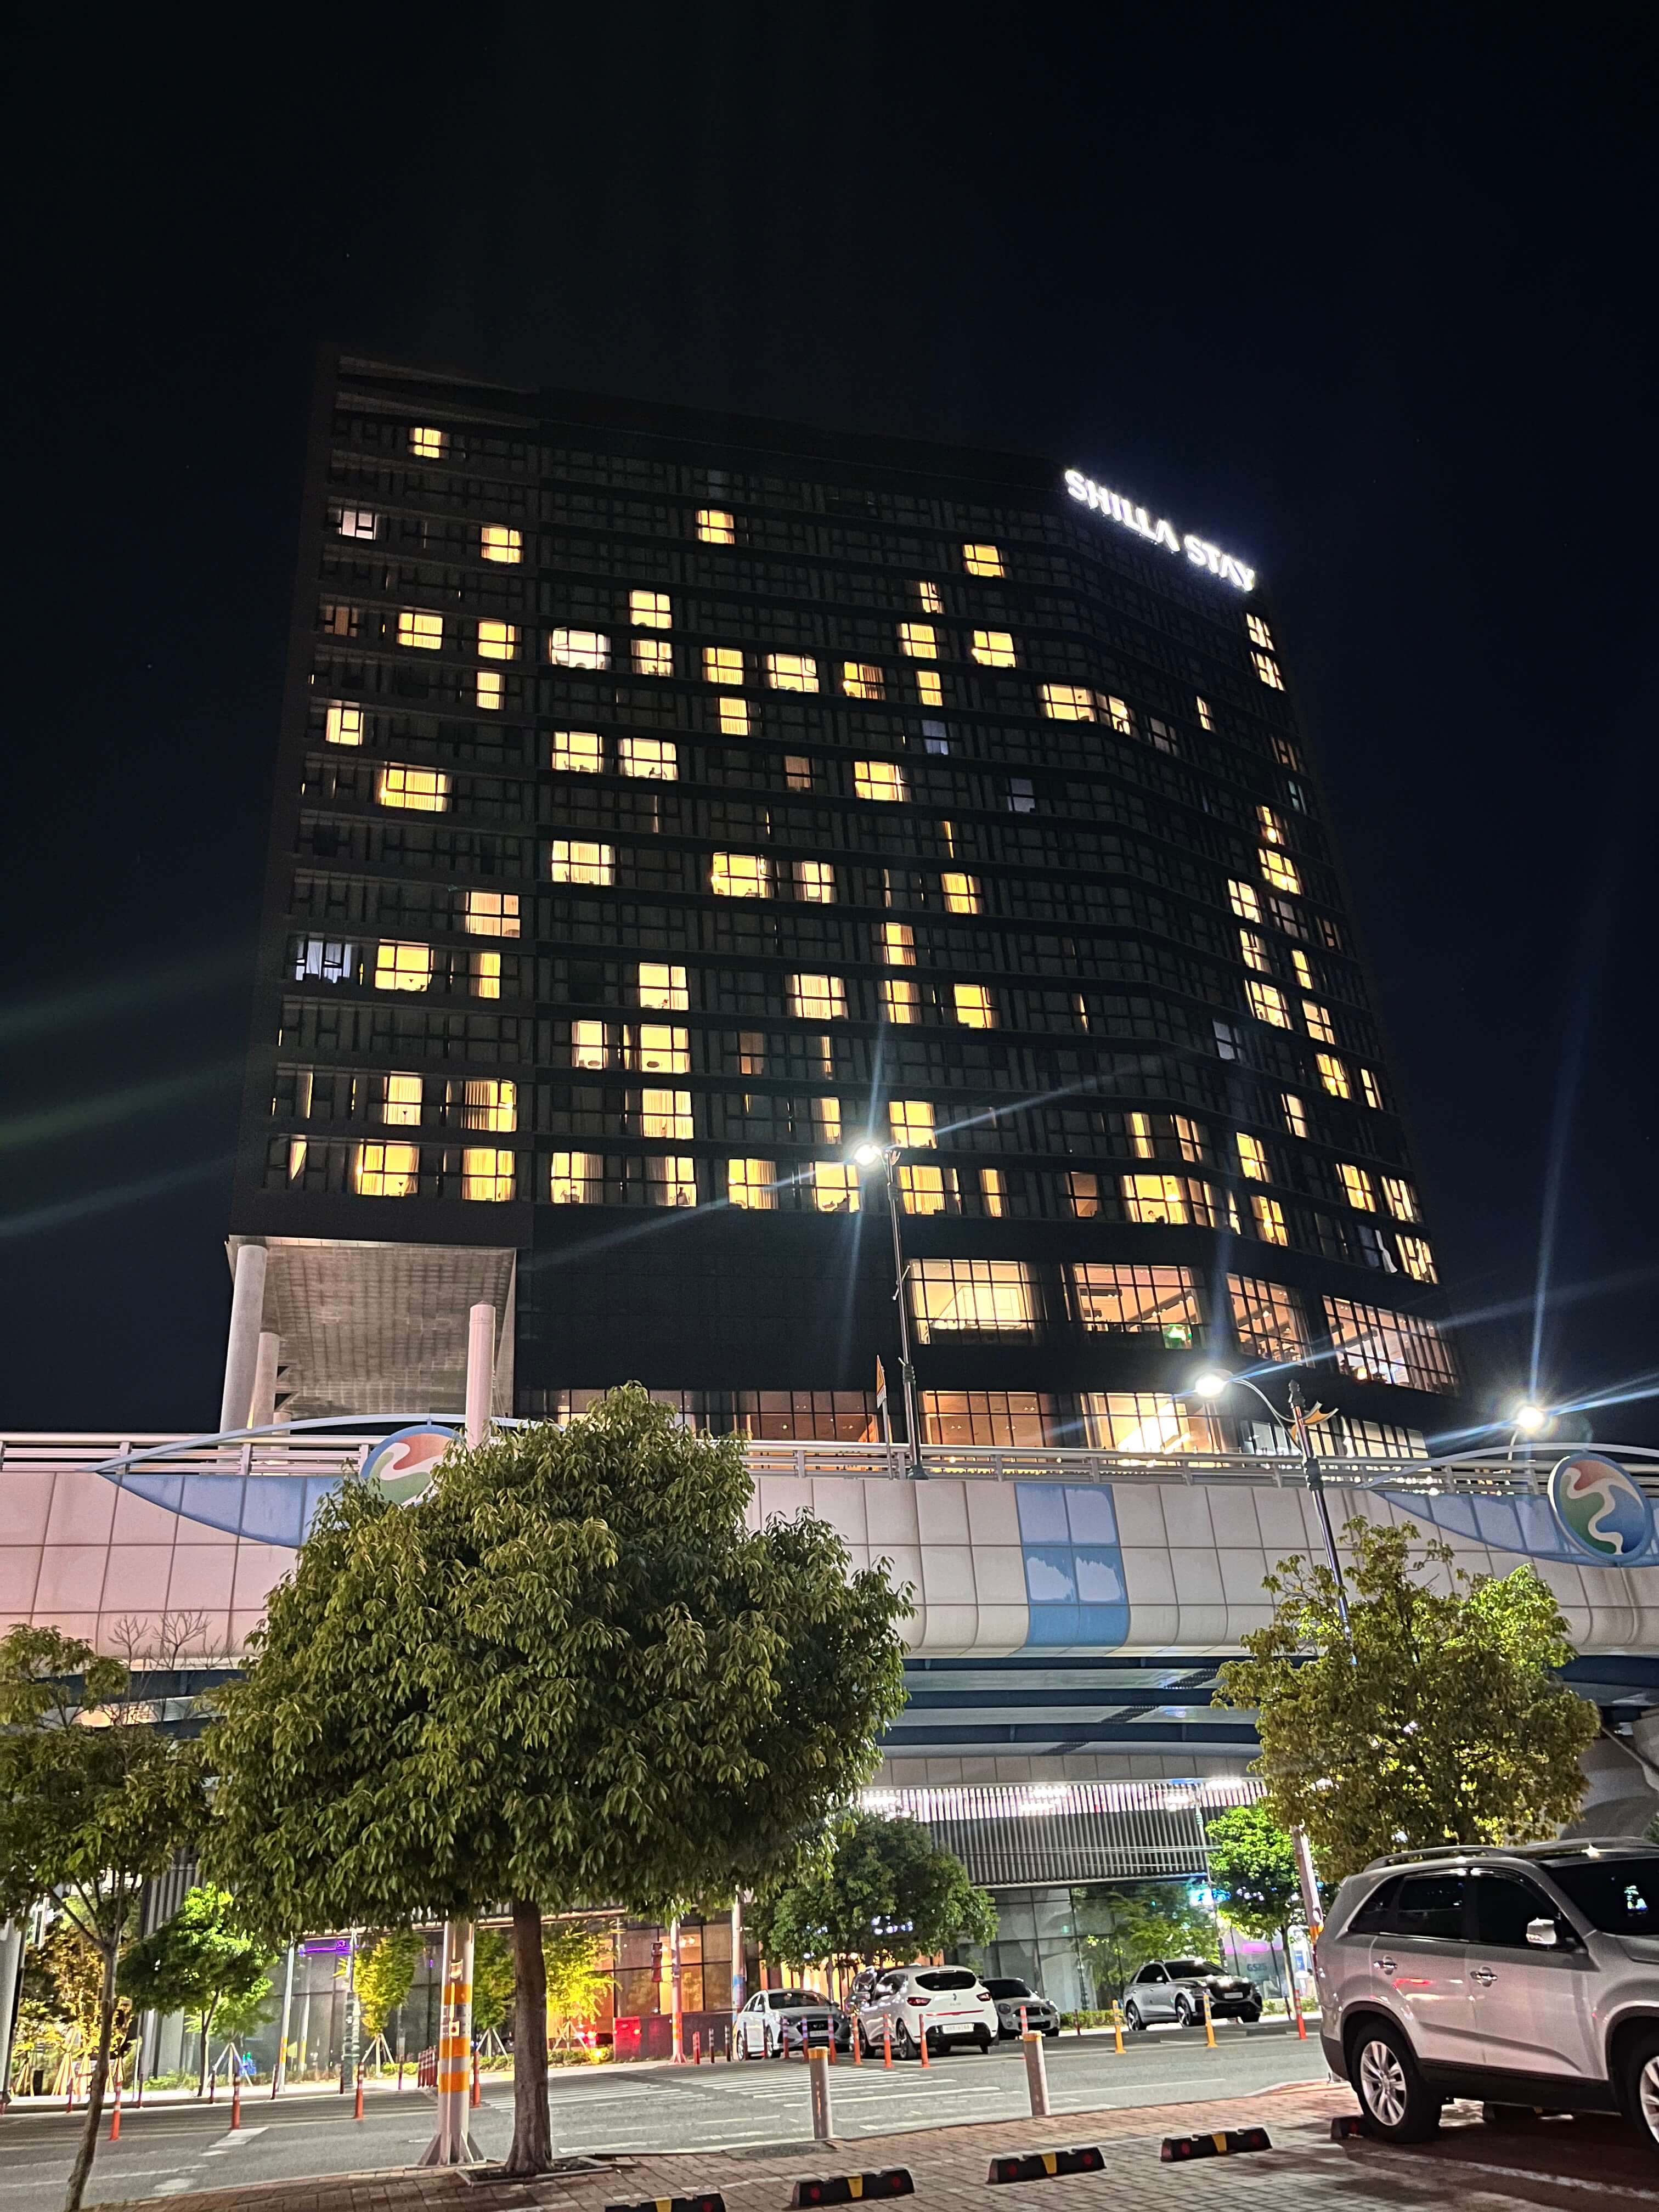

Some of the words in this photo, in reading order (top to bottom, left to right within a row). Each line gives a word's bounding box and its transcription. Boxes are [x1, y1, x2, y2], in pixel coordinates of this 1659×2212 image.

[1065, 469, 1180, 552] SHILLA
[1184, 535, 1255, 591] STAY
[1247, 1963, 1267, 1972] GS25
